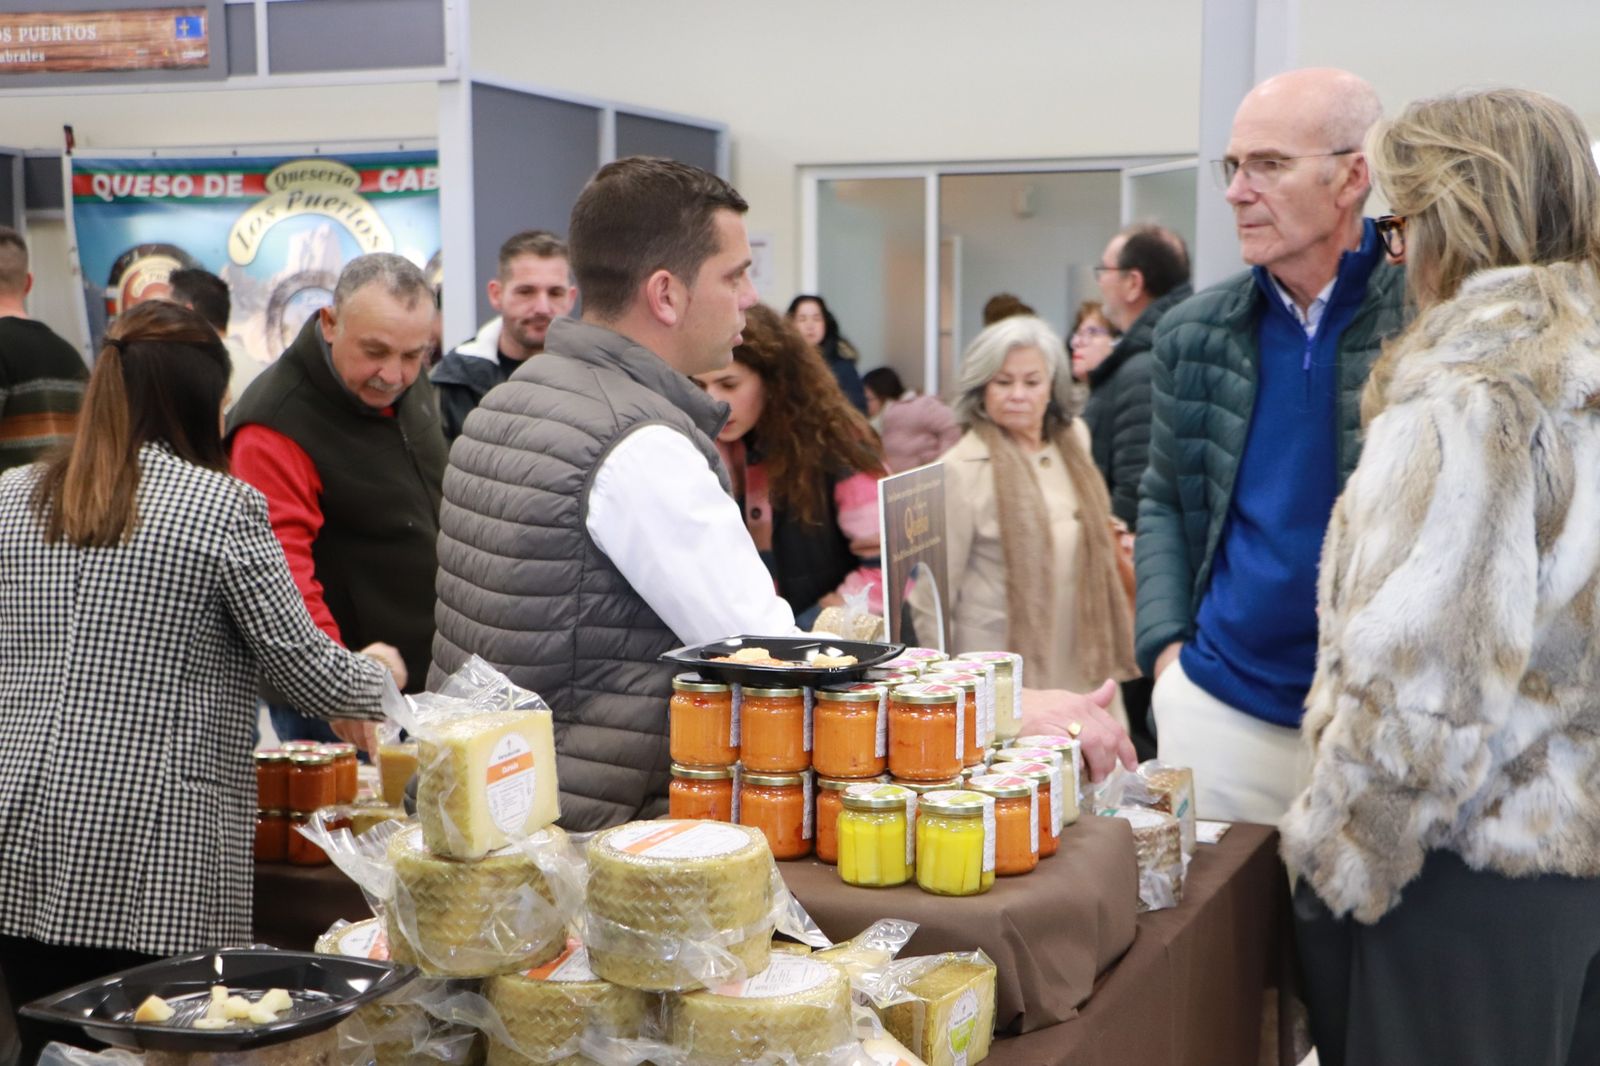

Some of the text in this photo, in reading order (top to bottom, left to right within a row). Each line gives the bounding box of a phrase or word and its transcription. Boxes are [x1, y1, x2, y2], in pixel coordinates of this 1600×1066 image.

[18, 25, 97, 43] PUERTOS
[91, 172, 194, 202] QUESO
[203, 172, 244, 198] DE
[274, 168, 355, 190] Quesería
[232, 189, 380, 250] Los Puertos
